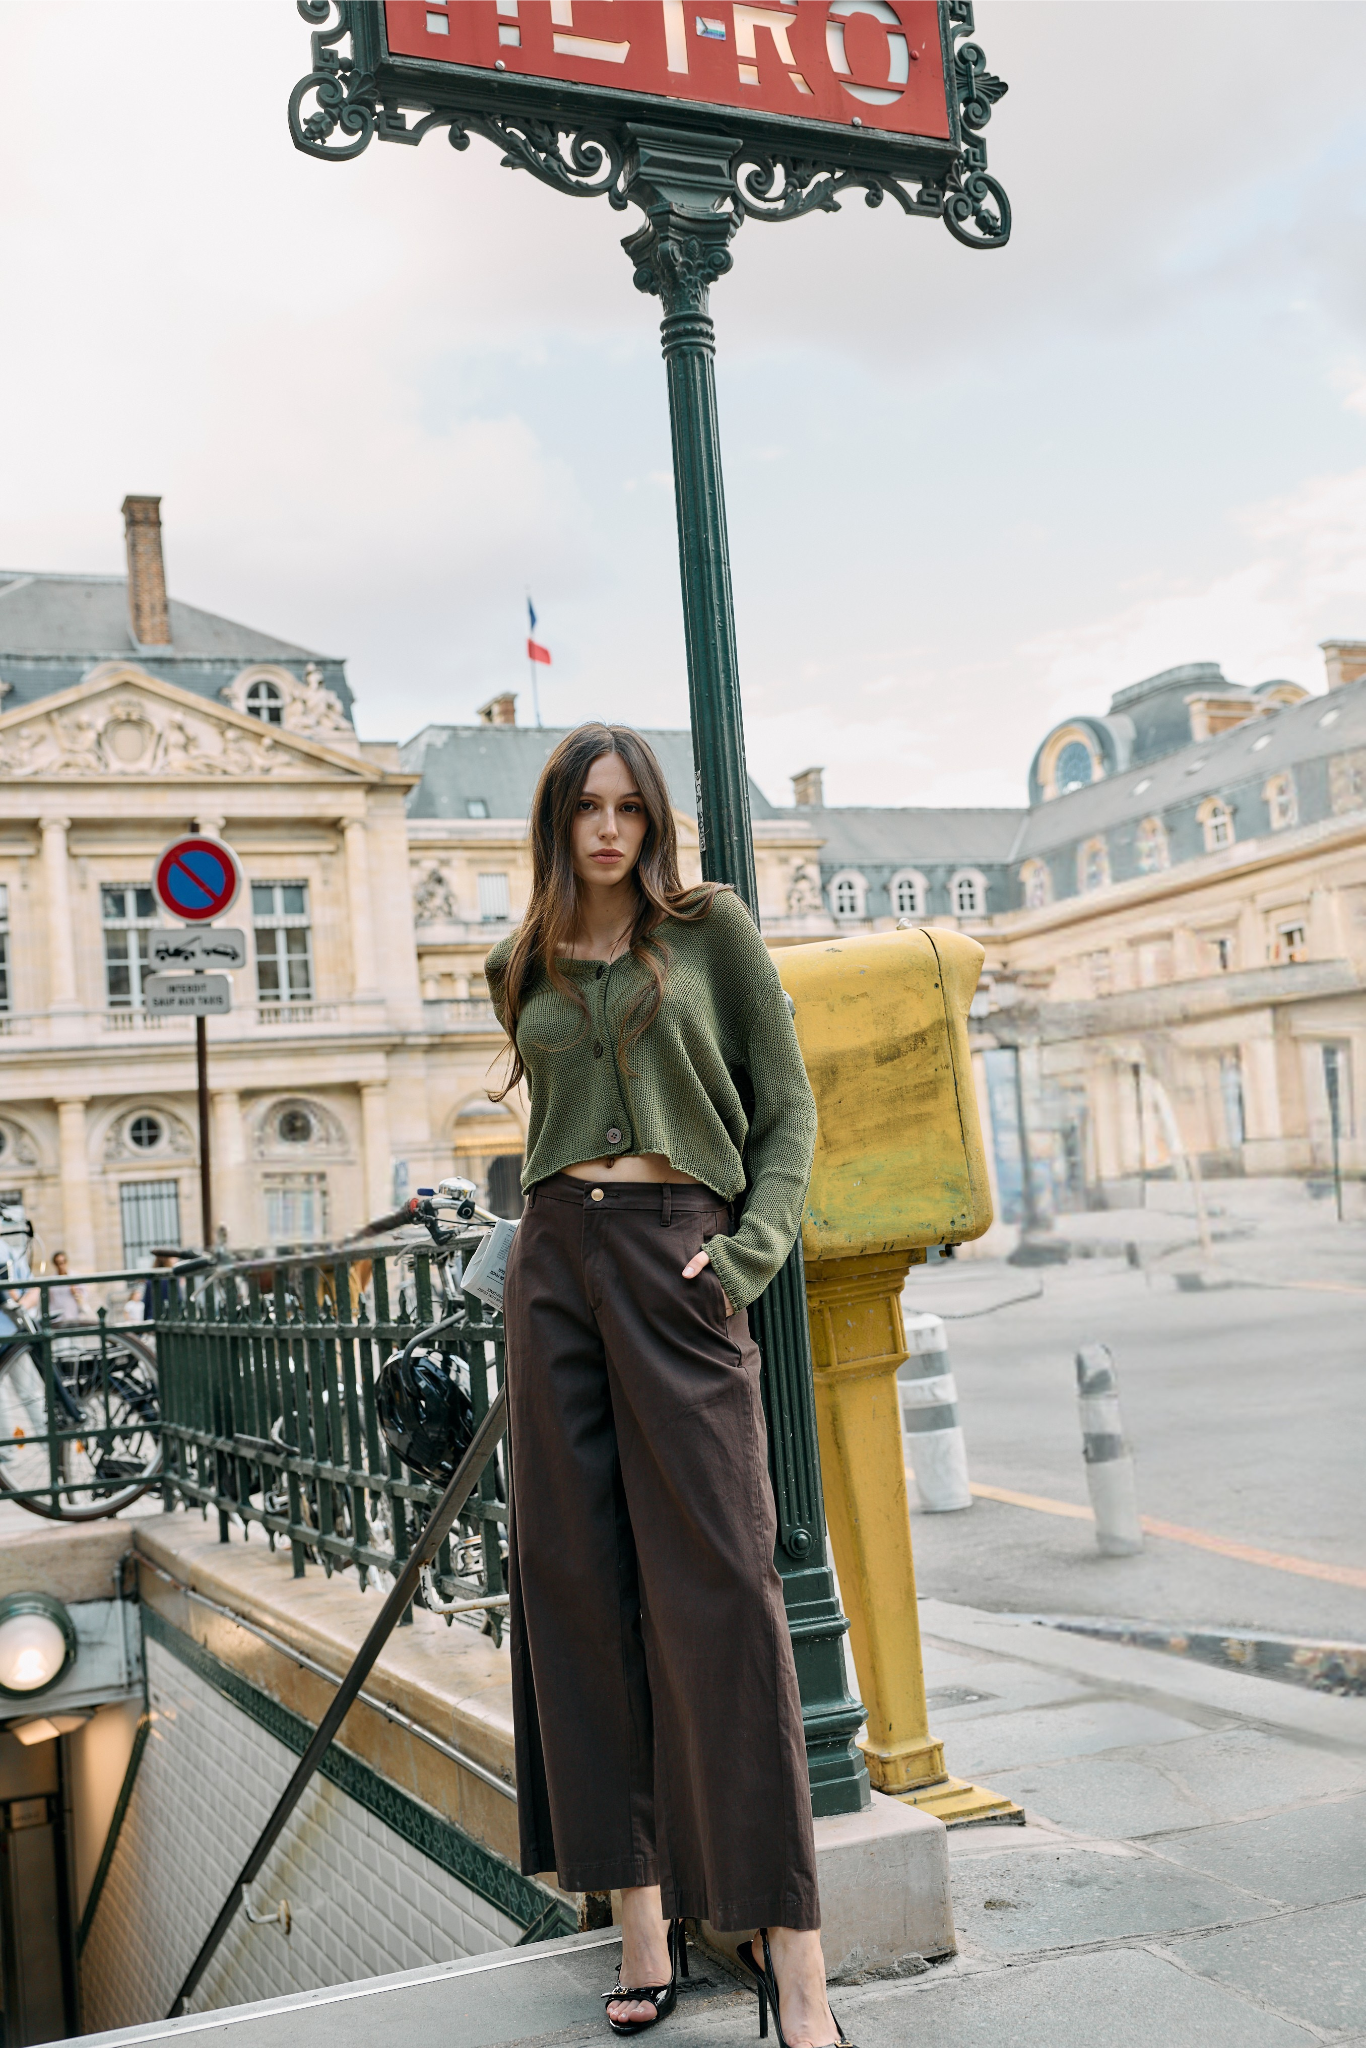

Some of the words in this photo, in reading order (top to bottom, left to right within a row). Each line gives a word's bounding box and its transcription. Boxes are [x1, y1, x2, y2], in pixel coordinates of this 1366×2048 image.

[167, 983, 206, 994] INTERDIT
[153, 997, 175, 1007] SAUF
[178, 996, 195, 1006] AUX
[198, 995, 223, 1006] TAXIS
